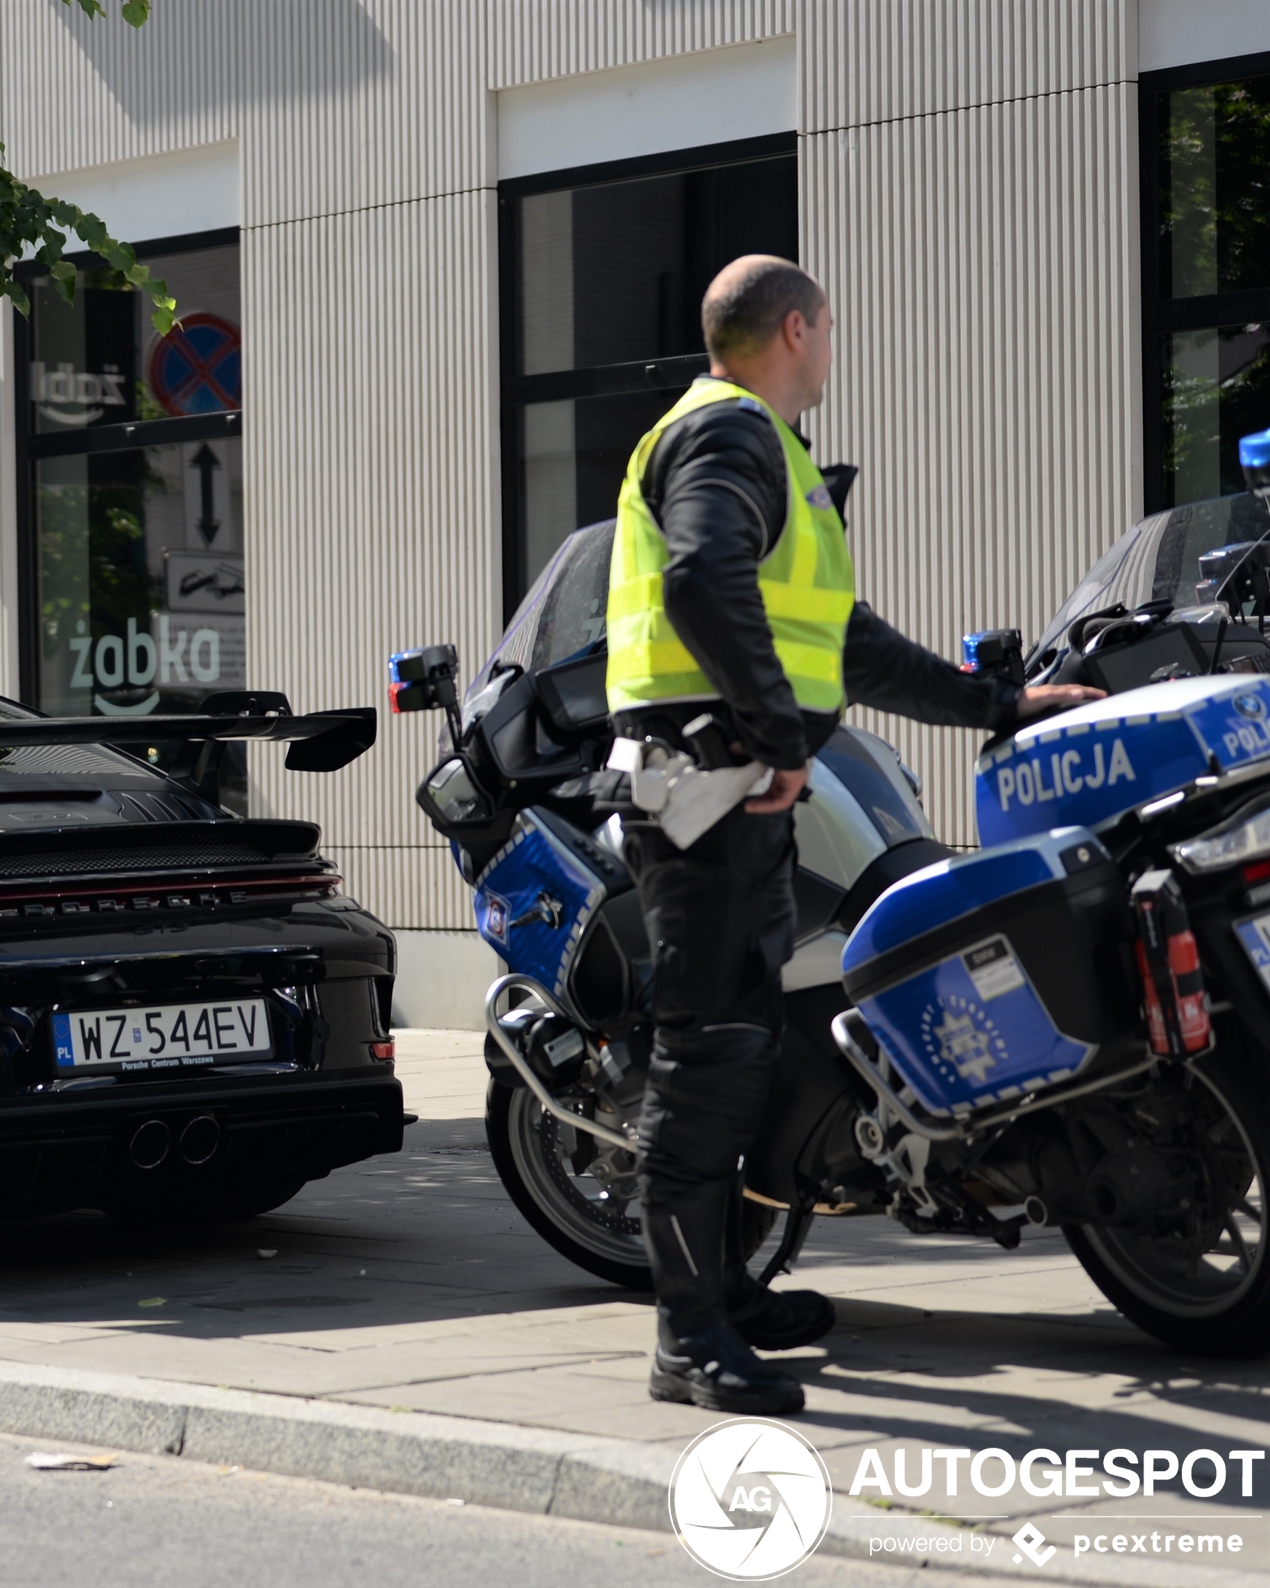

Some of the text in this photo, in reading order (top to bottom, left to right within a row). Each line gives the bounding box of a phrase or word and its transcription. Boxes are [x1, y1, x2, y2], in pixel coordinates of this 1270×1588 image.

[69, 616, 220, 688] żabka
[997, 738, 1137, 812] POLICJA
[24, 890, 249, 917] PORSCHE
[79, 1004, 257, 1061] WZ 544EV
[57, 1048, 71, 1060] PL
[122, 1055, 214, 1071] Porsche Centrum Warszawa
